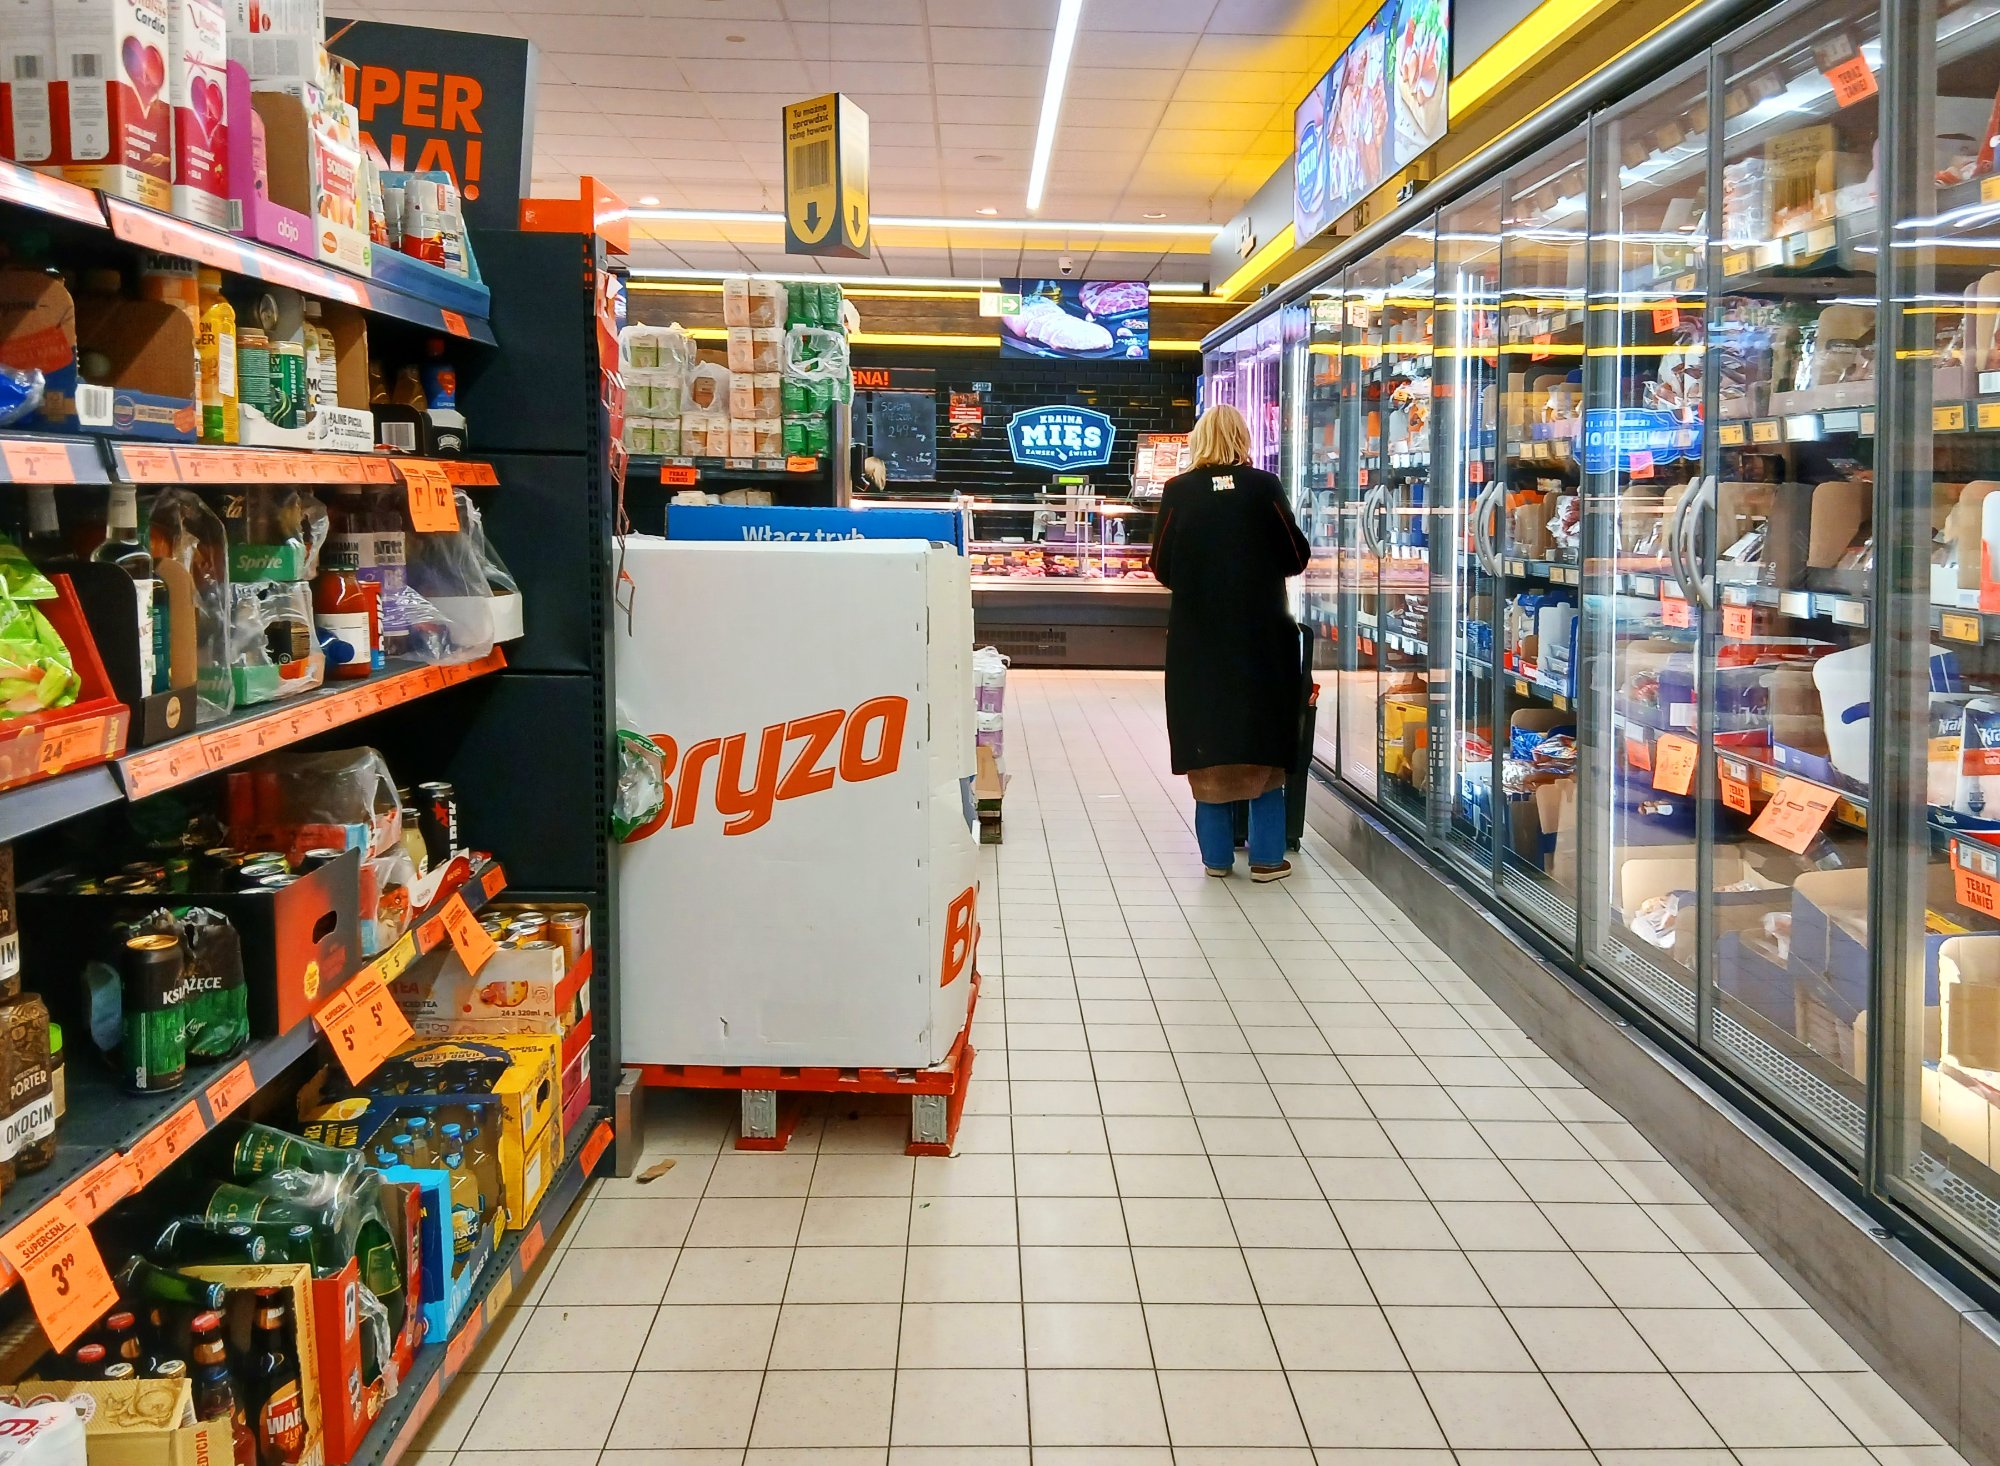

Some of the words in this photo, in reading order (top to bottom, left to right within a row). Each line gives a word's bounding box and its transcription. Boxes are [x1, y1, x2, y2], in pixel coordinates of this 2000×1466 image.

[135, 7, 166, 35] Cardio
[793, 109, 802, 118] Tu
[803, 103, 828, 116] można
[792, 111, 829, 130] sprawdzić
[789, 131, 805, 141] cenę
[806, 124, 833, 136] towaru
[289, 359, 298, 403] STARBUCKS
[1040, 415, 1083, 425] KRAINA
[1021, 425, 1102, 451] MIĘS
[1148, 436, 1170, 444] SUPER
[236, 553, 283, 572] Sprite
[1966, 876, 1993, 897] TERAZ
[1967, 890, 1994, 910] TANIEJ
[422, 1000, 438, 1009] TEA
[501, 1009, 511, 1017] 24
[517, 1009, 541, 1017] 320ml
[11, 1069, 48, 1100] PORTER
[6, 1101, 54, 1145] OKOCIM
[22, 1222, 67, 1259] SUPERCENA
